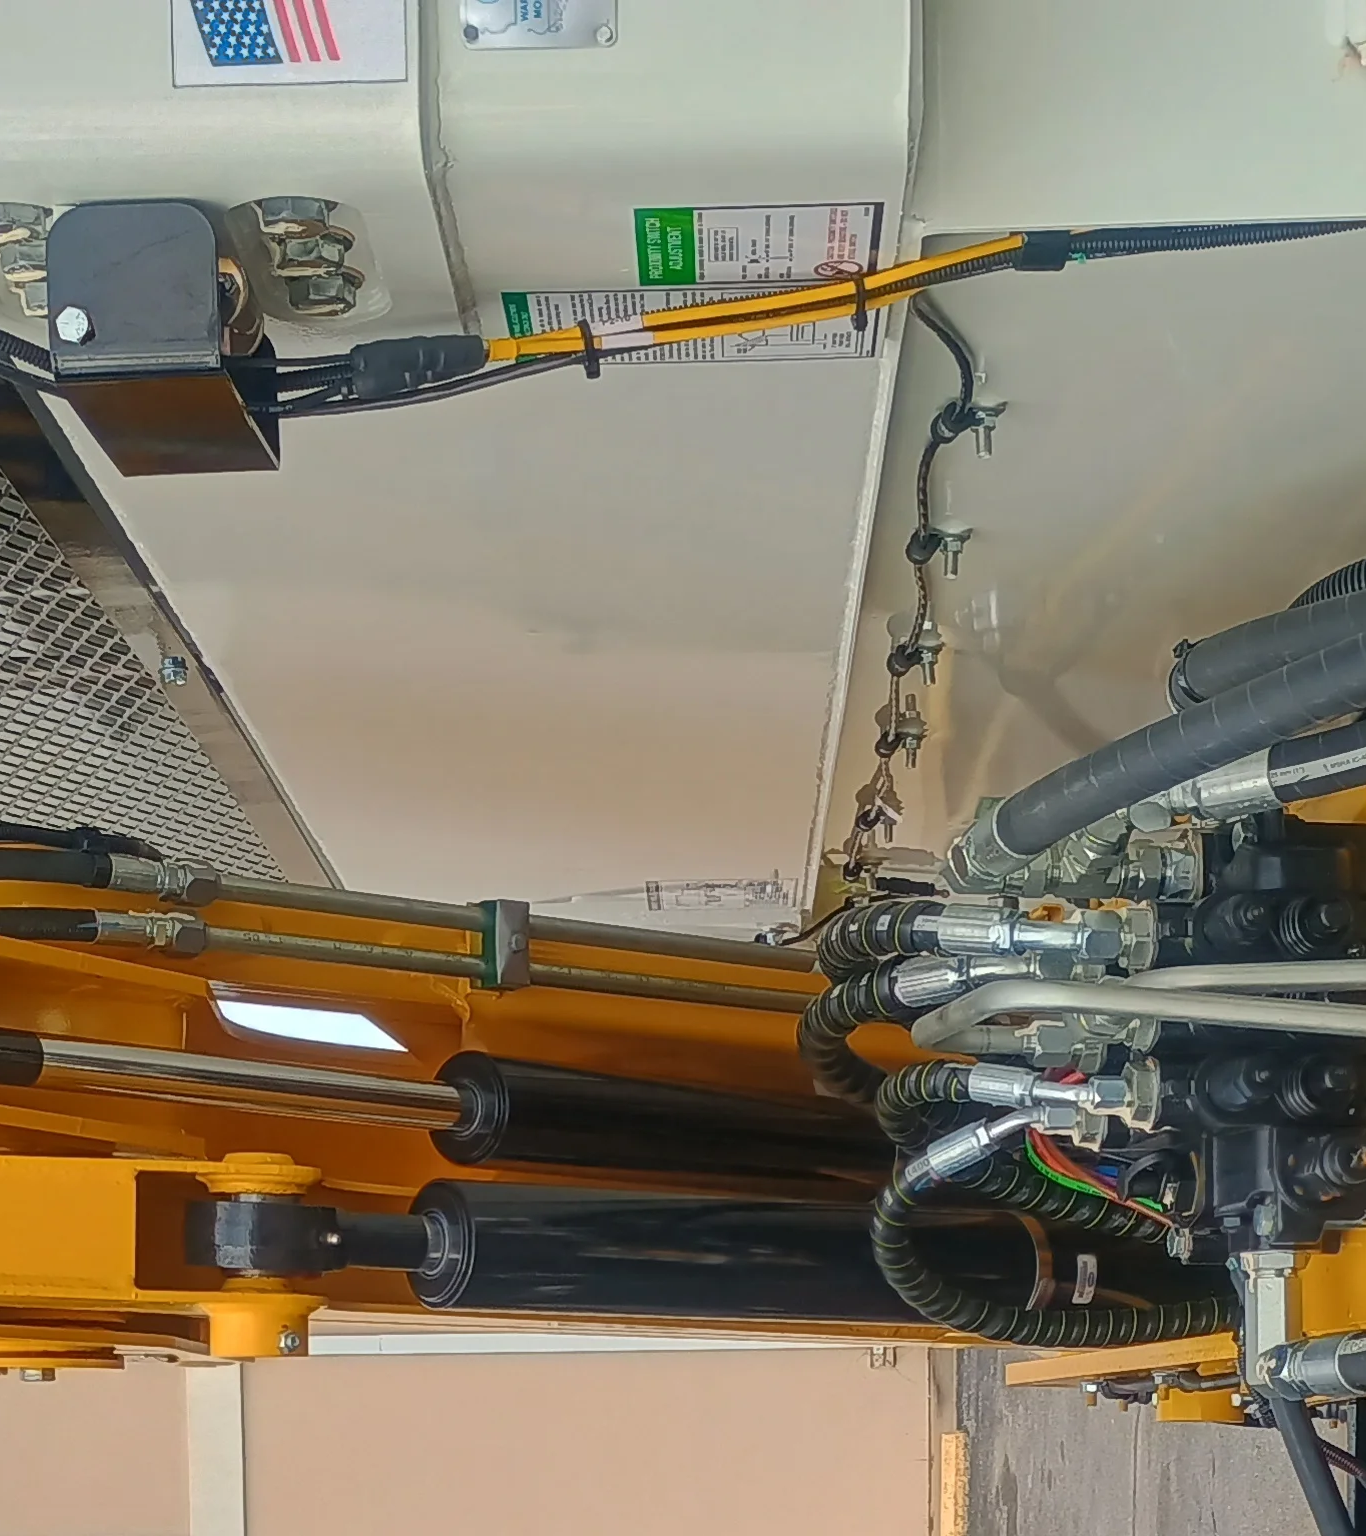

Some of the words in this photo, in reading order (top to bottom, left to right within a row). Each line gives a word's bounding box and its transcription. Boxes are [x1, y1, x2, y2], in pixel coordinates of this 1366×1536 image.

[520, 0, 529, 22] WA
[644, 217, 661, 244] SWITCH
[667, 226, 683, 270] ADJUSTMENT
